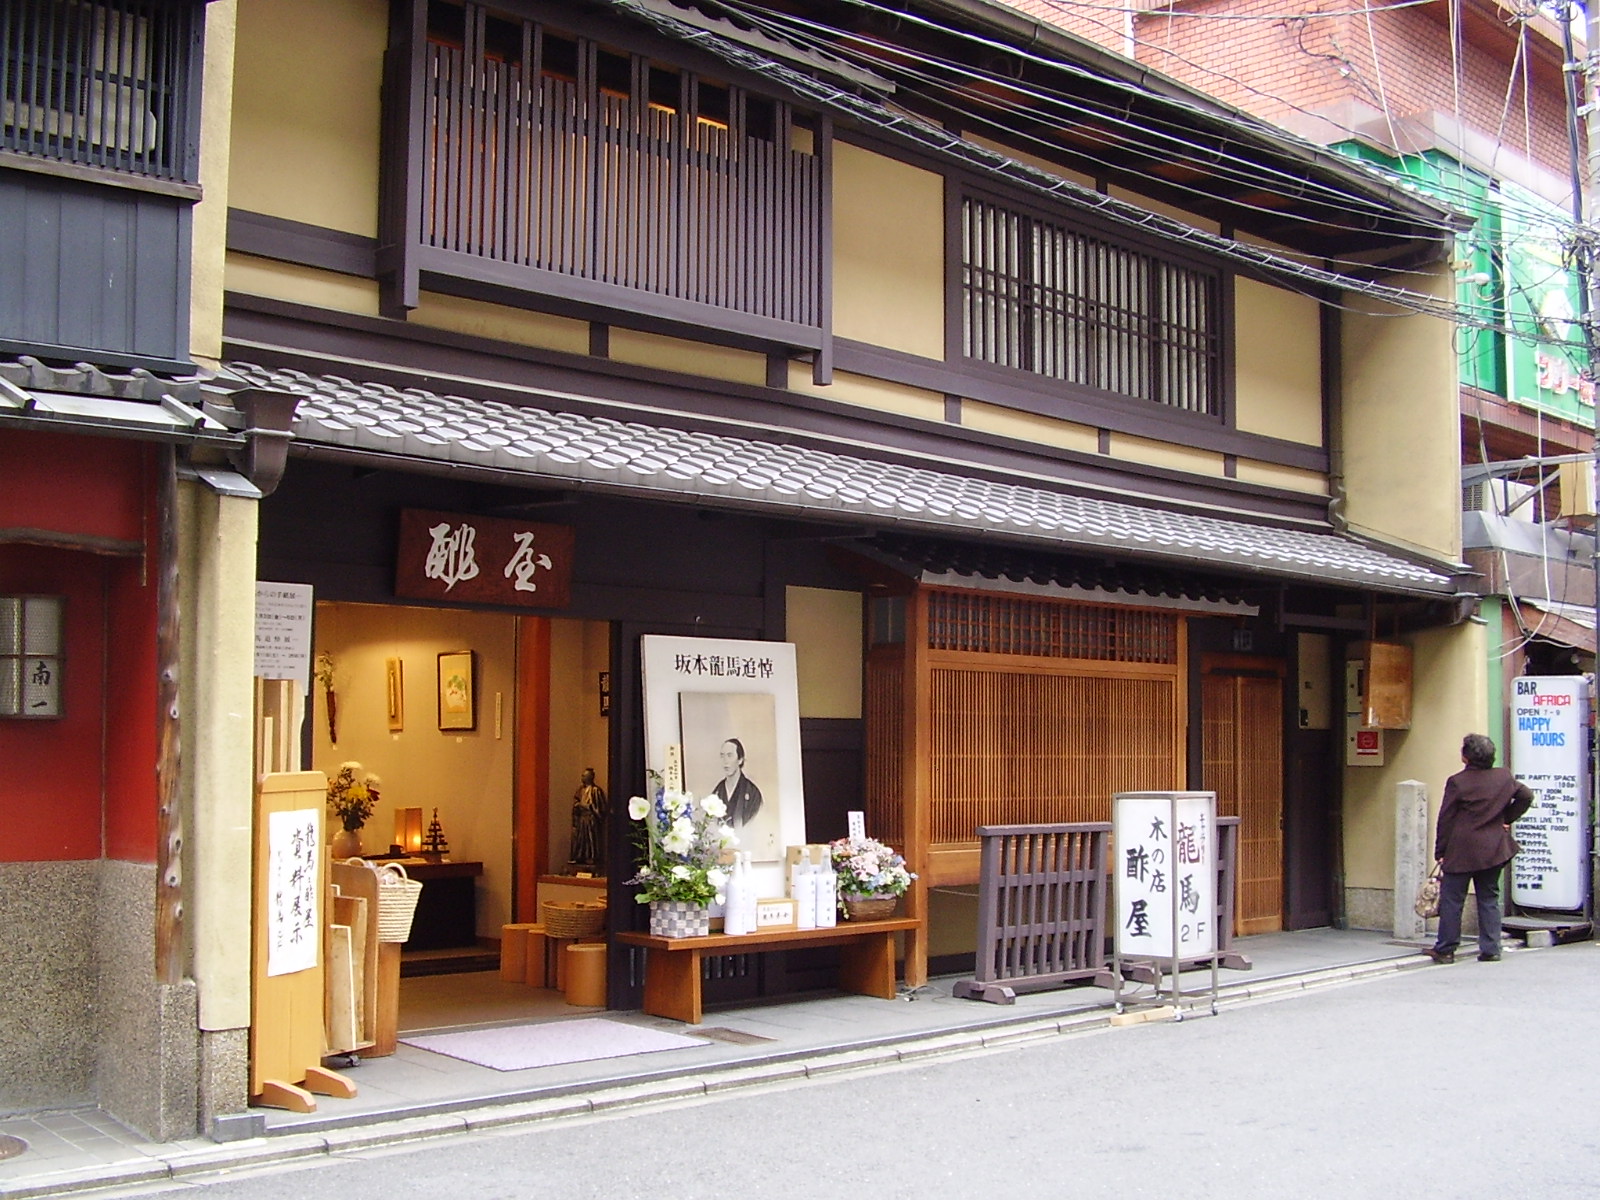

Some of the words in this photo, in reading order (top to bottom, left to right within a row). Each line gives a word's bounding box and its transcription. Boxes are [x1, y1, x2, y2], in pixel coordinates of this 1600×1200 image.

[675, 654, 774, 679] 坂本龍馬追悼
[1517, 681, 1537, 695] BAR
[1533, 695, 1571, 706] AFRICA
[1517, 708, 1539, 716] OPEN
[1518, 717, 1551, 731] HAPPY
[1532, 732, 1565, 747] HOURS
[1554, 774, 1576, 782] SPACE
[1515, 823, 1547, 831] HANDMADE
[1149, 816, 1168, 893] 木の店
[1177, 822, 1200, 914] 龍馬
[1126, 845, 1152, 938] 酢屋
